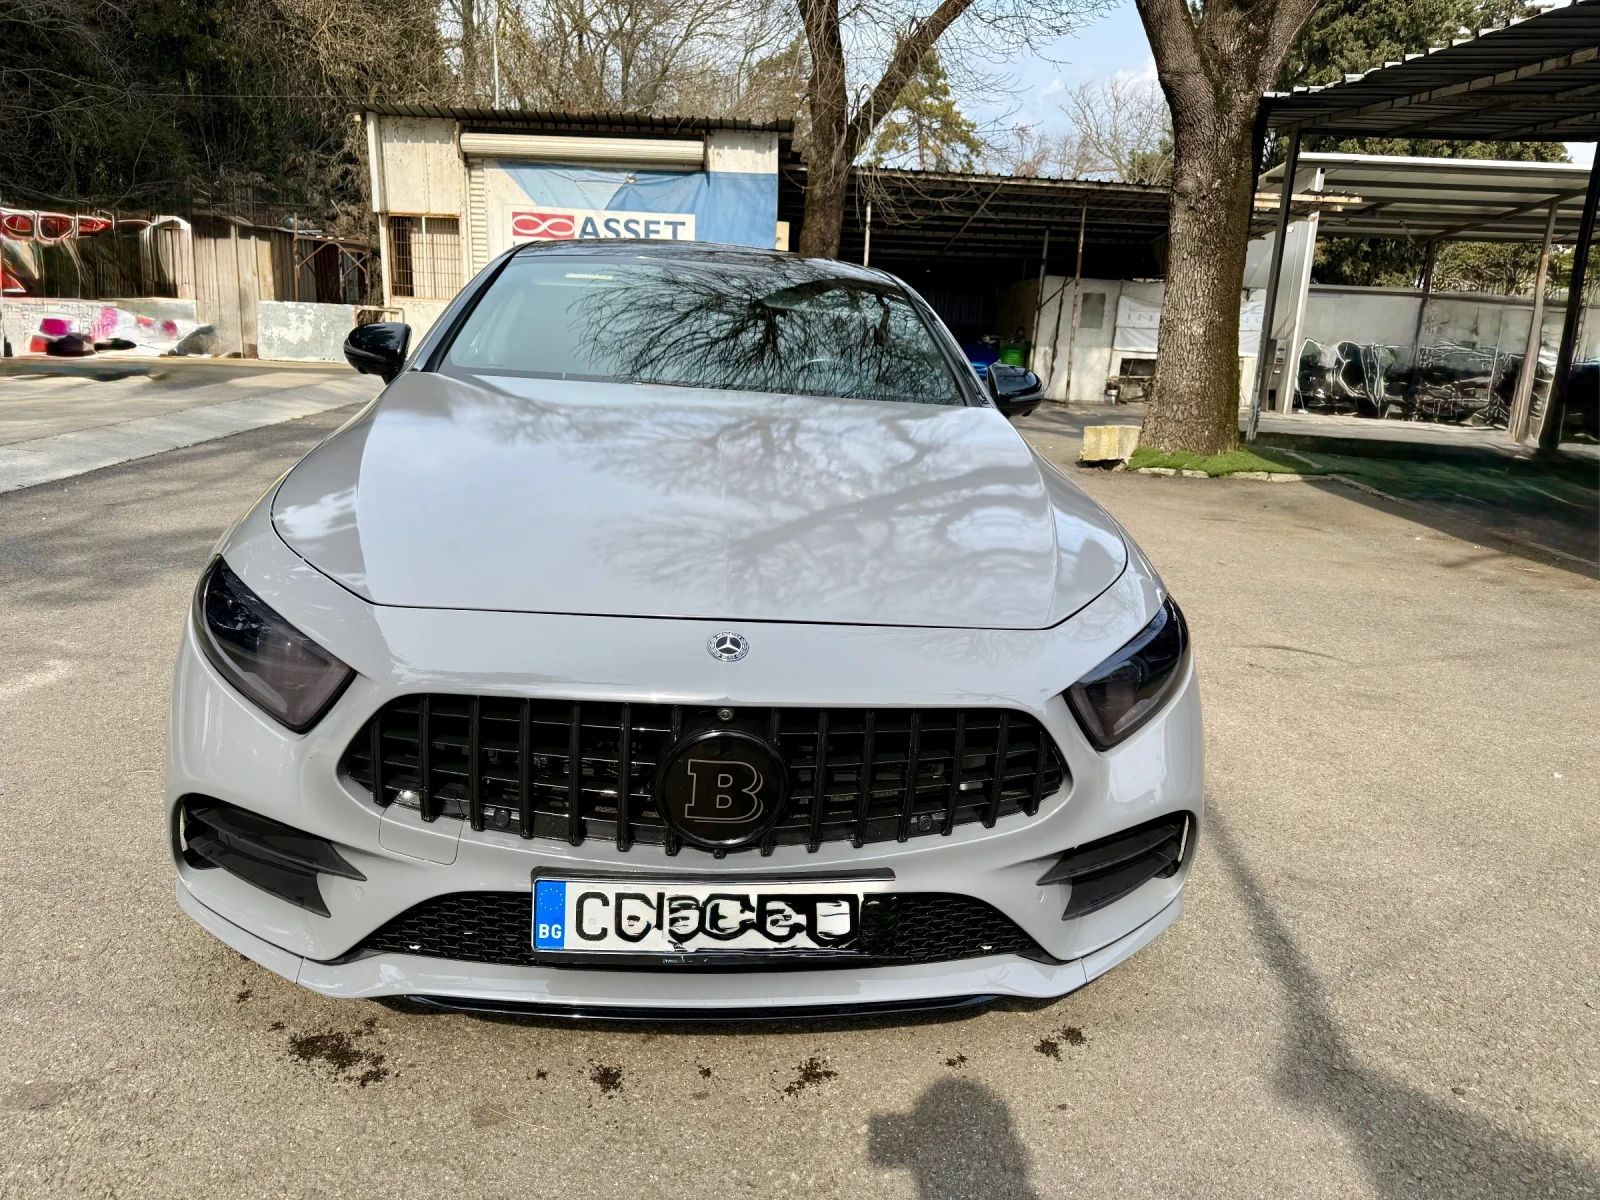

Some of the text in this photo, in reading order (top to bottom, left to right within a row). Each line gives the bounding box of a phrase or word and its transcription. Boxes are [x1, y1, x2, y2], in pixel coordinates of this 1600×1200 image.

[578, 216, 686, 240] ASSET
[684, 758, 764, 823] B
[538, 923, 562, 939] BG
